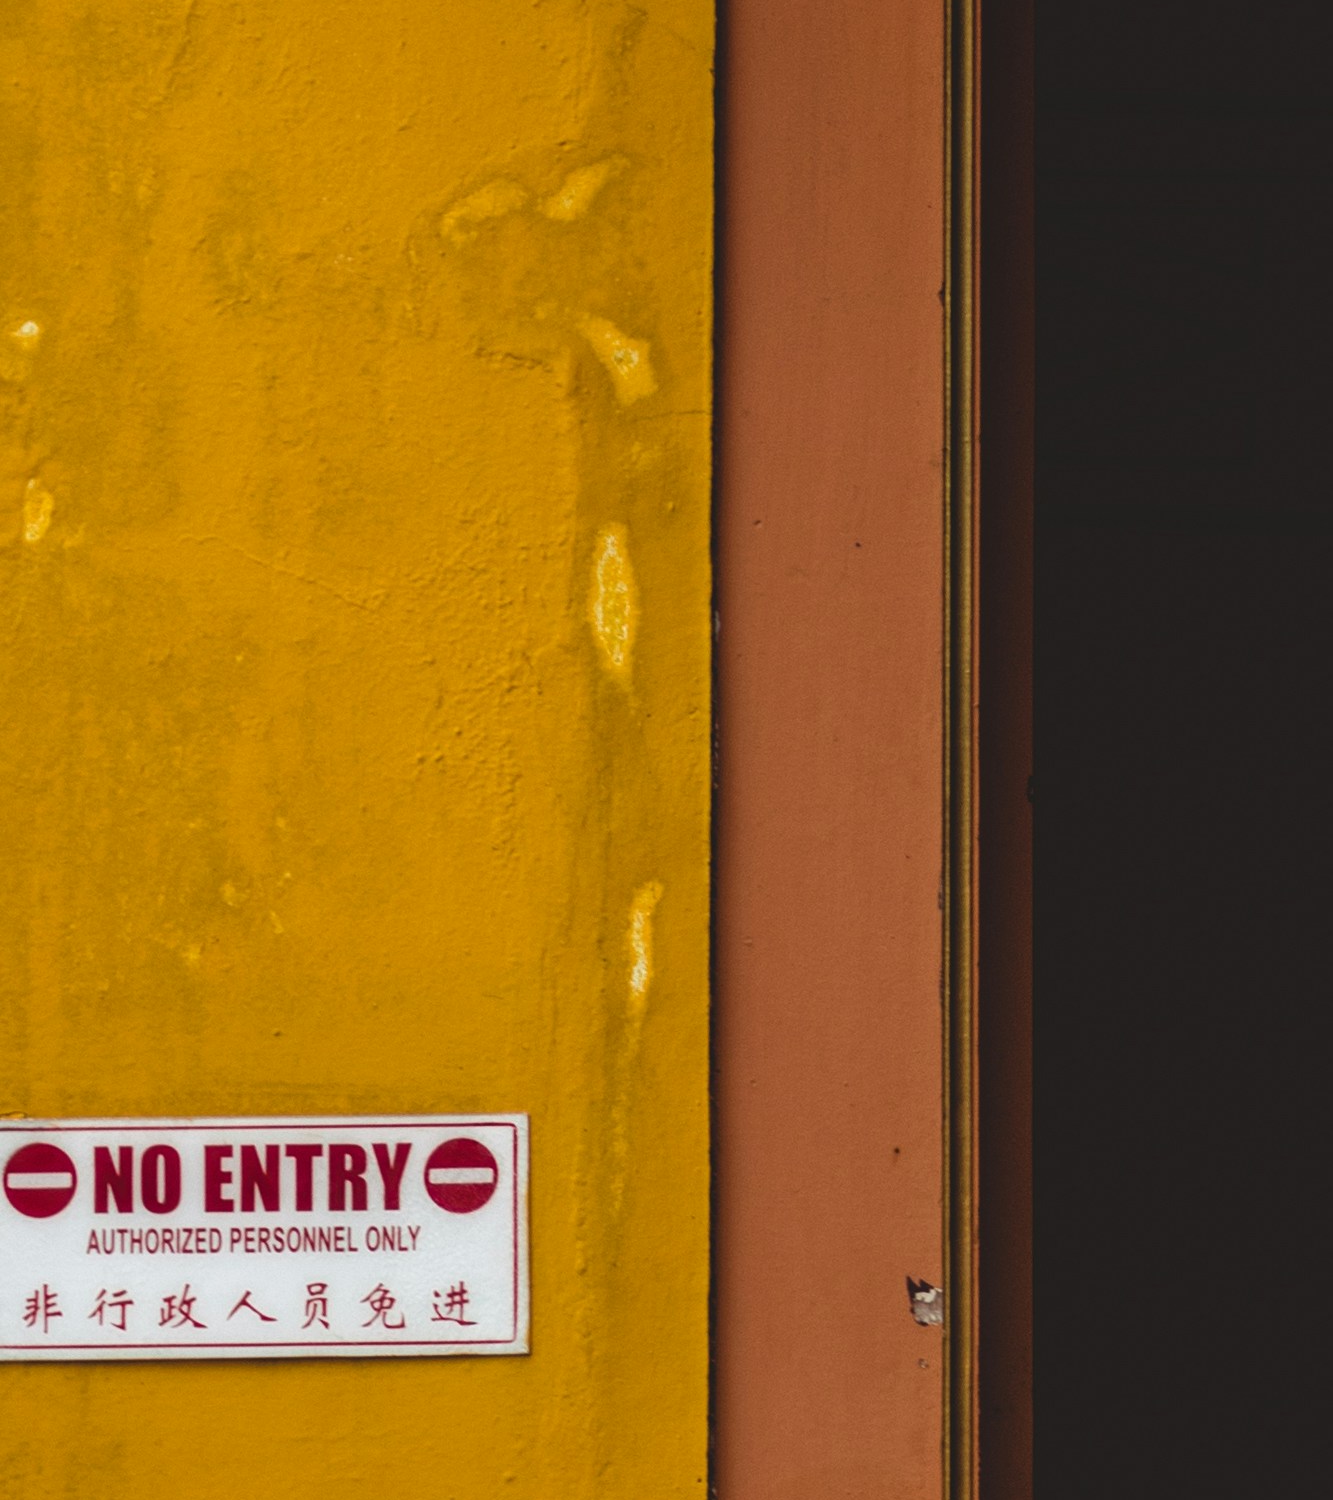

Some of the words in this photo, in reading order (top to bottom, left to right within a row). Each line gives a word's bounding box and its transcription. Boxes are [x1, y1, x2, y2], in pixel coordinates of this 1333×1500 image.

[93, 1143, 181, 1214] NO
[204, 1142, 412, 1213] ENTRY
[86, 1227, 223, 1254] AUTHORIZED
[230, 1226, 358, 1253] PERSONNEL
[365, 1225, 421, 1252] ONLY
[22, 1280, 478, 1334] 非行政人员免进
